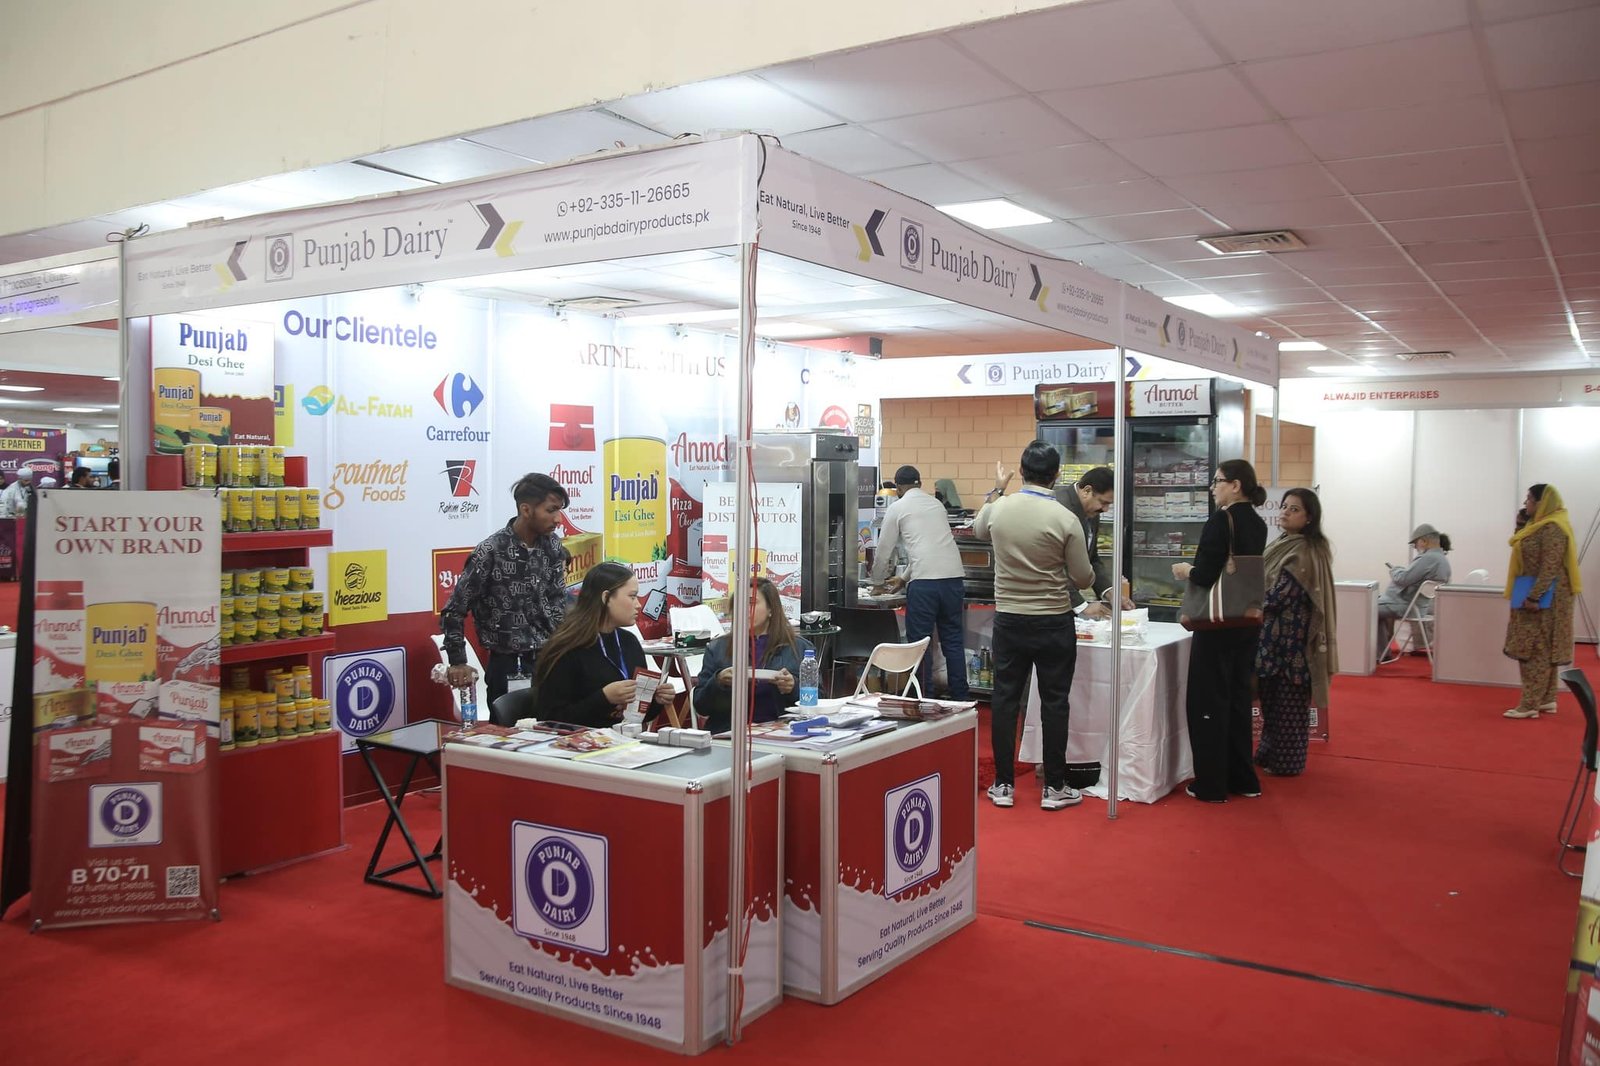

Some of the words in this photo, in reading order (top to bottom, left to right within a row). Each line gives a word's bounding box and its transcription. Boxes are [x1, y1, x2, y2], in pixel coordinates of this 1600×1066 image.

[569, 182, 690, 213] +92-335-11-26665
[760, 190, 774, 206] Eat
[776, 195, 807, 218] Natural,
[809, 206, 825, 222] Live
[827, 212, 850, 230] Better
[544, 209, 709, 243] www.punjabdairyproducts.pk
[792, 219, 808, 233] Since
[808, 224, 822, 236] 1948
[303, 231, 375, 270] Punjab
[383, 221, 448, 259] Dairy
[190, 262, 212, 273] Better
[930, 237, 979, 282] Punjab
[982, 254, 1018, 298] Dairy
[16, 294, 60, 314] progression
[179, 322, 248, 353] Punjab
[283, 310, 332, 339] Our
[336, 316, 437, 350] Clientele
[1189, 327, 1211, 355] Punjab
[188, 354, 213, 366] Desi
[216, 356, 245, 369] Ghee
[706, 356, 726, 378] US
[1013, 363, 1061, 382] Punjab
[1067, 362, 1107, 380] Dairy
[159, 384, 194, 402] Punjab
[1144, 383, 1199, 404] Anmol
[1323, 391, 1367, 401] ALWAJID
[1369, 390, 1440, 401] ENTERPRISES
[199, 412, 222, 423] Punjab
[426, 425, 490, 443] Carrefour
[8, 439, 42, 449] PARTNER
[549, 464, 594, 484] Anmol
[324, 459, 409, 510] gourmet
[362, 486, 406, 502] Foods
[672, 497, 692, 511] Pizza
[777, 495, 786, 507] A
[55, 516, 131, 532] START
[138, 516, 204, 532] YOUR
[633, 509, 655, 521] Ghee
[55, 538, 114, 555] OWN
[121, 538, 203, 554] BRAND
[704, 556, 726, 566] Anmol
[766, 551, 798, 563] Anmol
[676, 582, 700, 597] Anmol
[157, 605, 217, 626] Anmol
[35, 618, 81, 634] Anmol
[92, 625, 147, 647] Punjab
[344, 666, 383, 686] PUNJAB
[170, 691, 208, 710] Punjab
[349, 713, 380, 731] DAIRY
[901, 796, 927, 819] PUNJAB
[87, 858, 105, 867] Visit
[538, 845, 581, 870] PUNJAB
[903, 844, 924, 865] DAIRY
[71, 868, 88, 884] B
[93, 865, 149, 883] 70-71
[904, 873, 914, 884] Since
[67, 885, 83, 893] For
[85, 883, 119, 892] further
[542, 901, 577, 922] DAIRY
[880, 925, 890, 939] Eat
[891, 911, 916, 932] Natural,
[916, 906, 928, 919] Live
[929, 896, 946, 912] Better
[544, 927, 560, 937] Since
[561, 931, 576, 942] 1948
[858, 947, 883, 968] Serving
[884, 934, 907, 952] Quality
[907, 919, 934, 941] Products
[934, 909, 949, 924] Since
[950, 900, 963, 915] 1948
[509, 961, 525, 972] Eat
[527, 966, 567, 988] Natural,
[569, 979, 589, 992] Live
[591, 983, 624, 1001] Better
[478, 970, 515, 992] Serving
[517, 980, 553, 1002] Quality
[555, 990, 601, 1013] Products
[603, 1004, 633, 1022] Since
[636, 1013, 662, 1029] 1948
